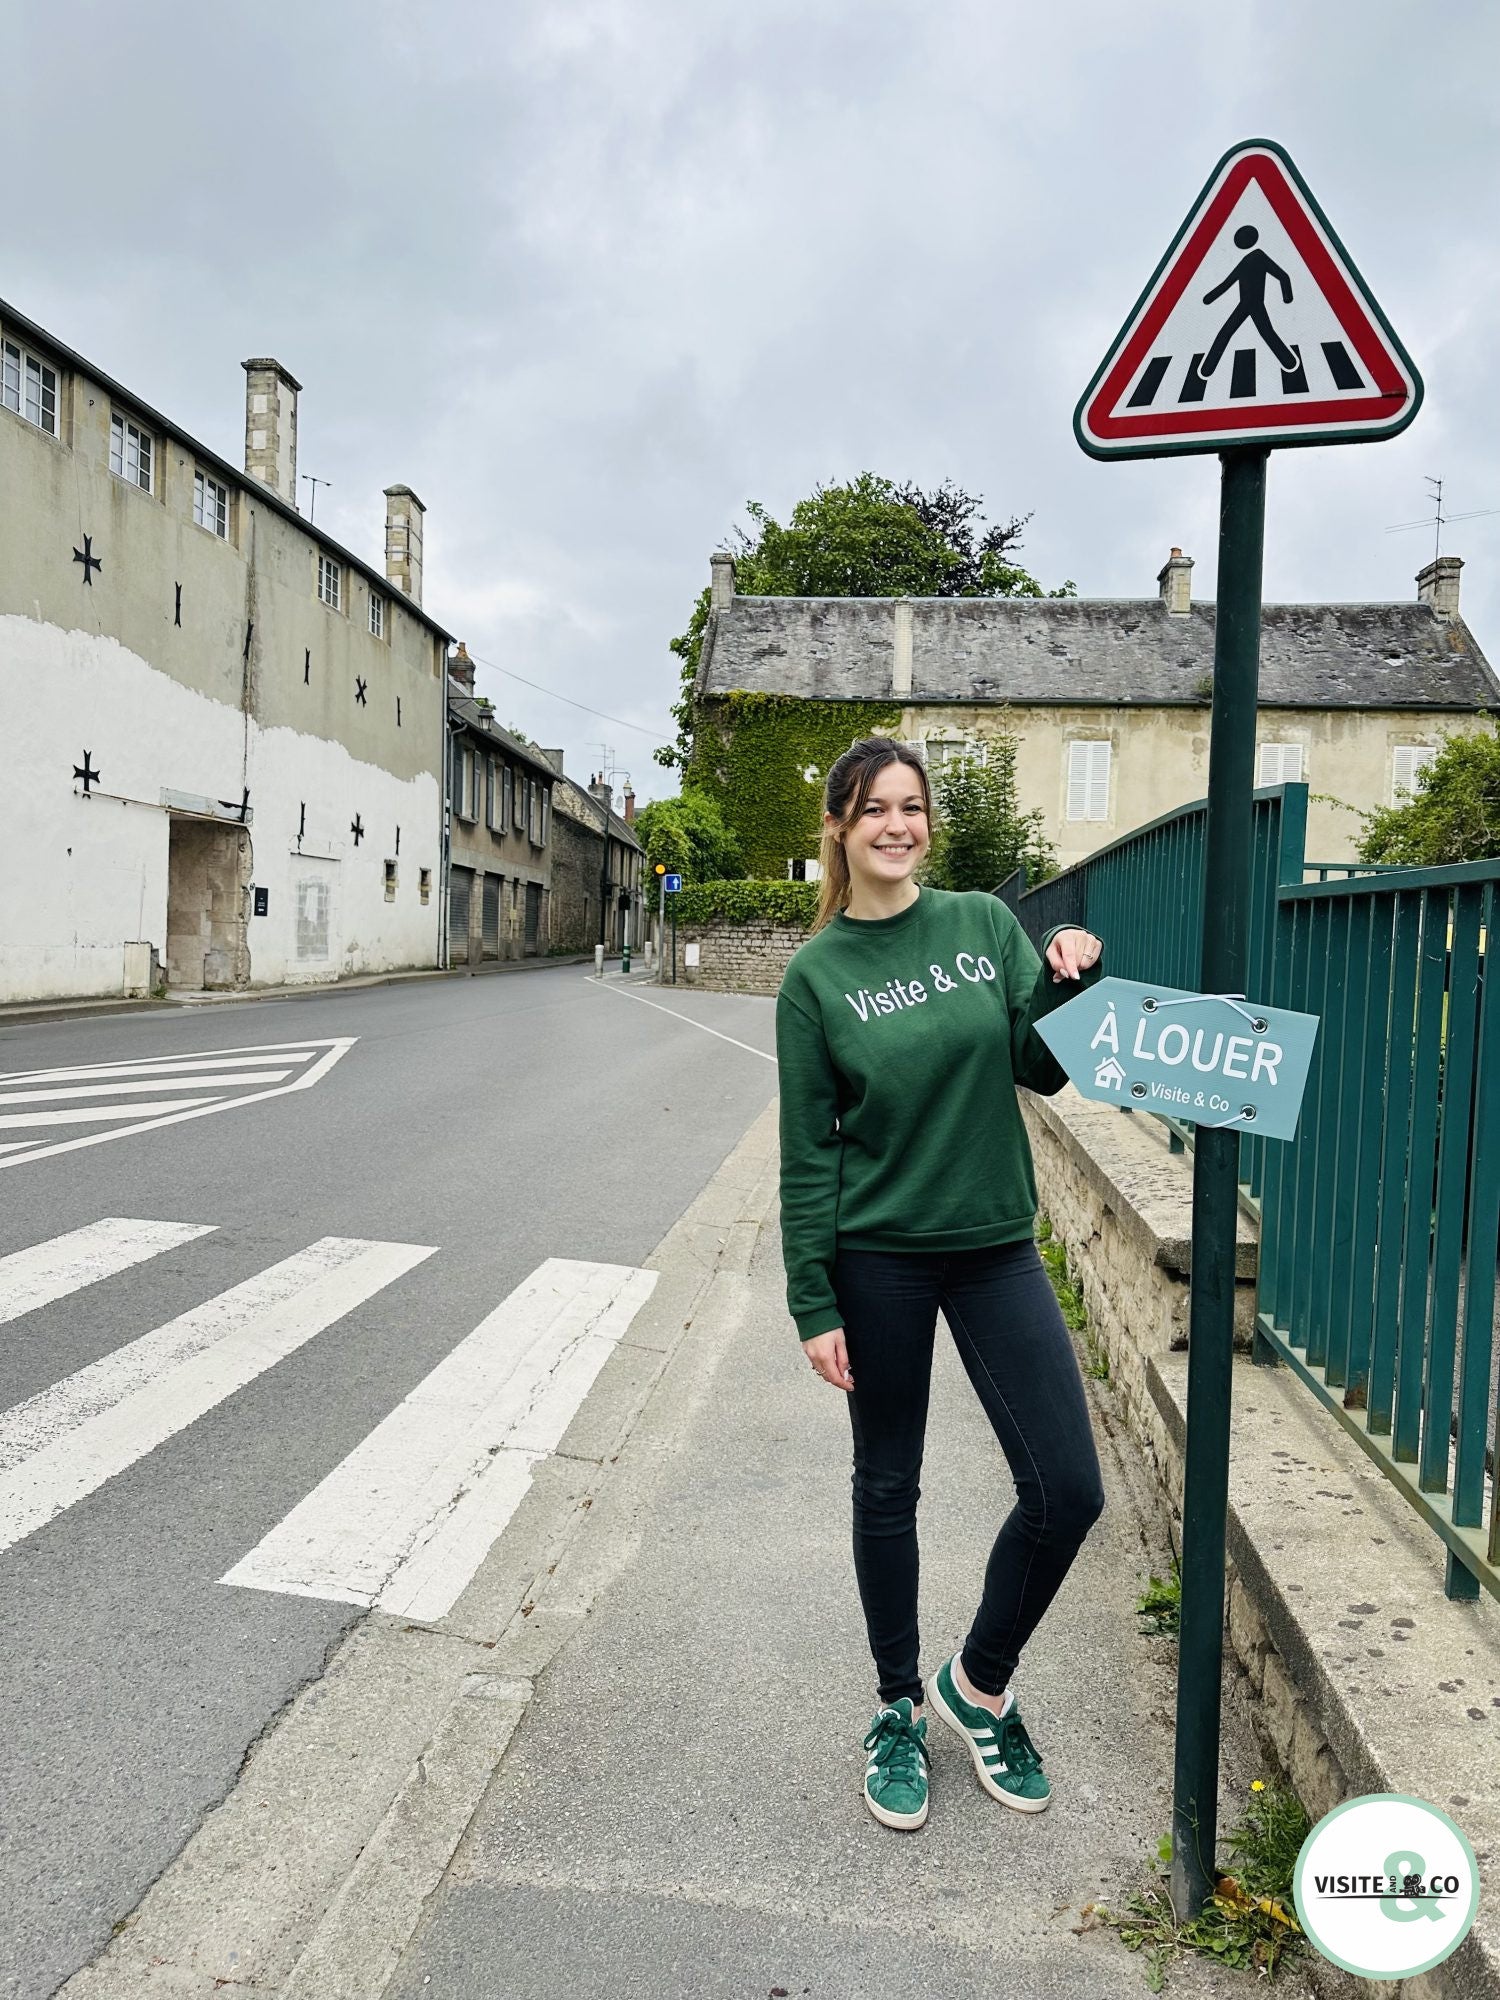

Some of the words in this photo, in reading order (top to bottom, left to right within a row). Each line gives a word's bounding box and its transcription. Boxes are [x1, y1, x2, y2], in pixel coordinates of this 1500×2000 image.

[845, 978, 928, 1022] Visite
[929, 964, 958, 993] &
[955, 952, 996, 983] Co
[1090, 1001, 1120, 1054] À
[1133, 1017, 1283, 1086] LOUER
[1151, 1081, 1190, 1104] Visite
[1193, 1091, 1205, 1107] &
[1209, 1094, 1230, 1112] Co
